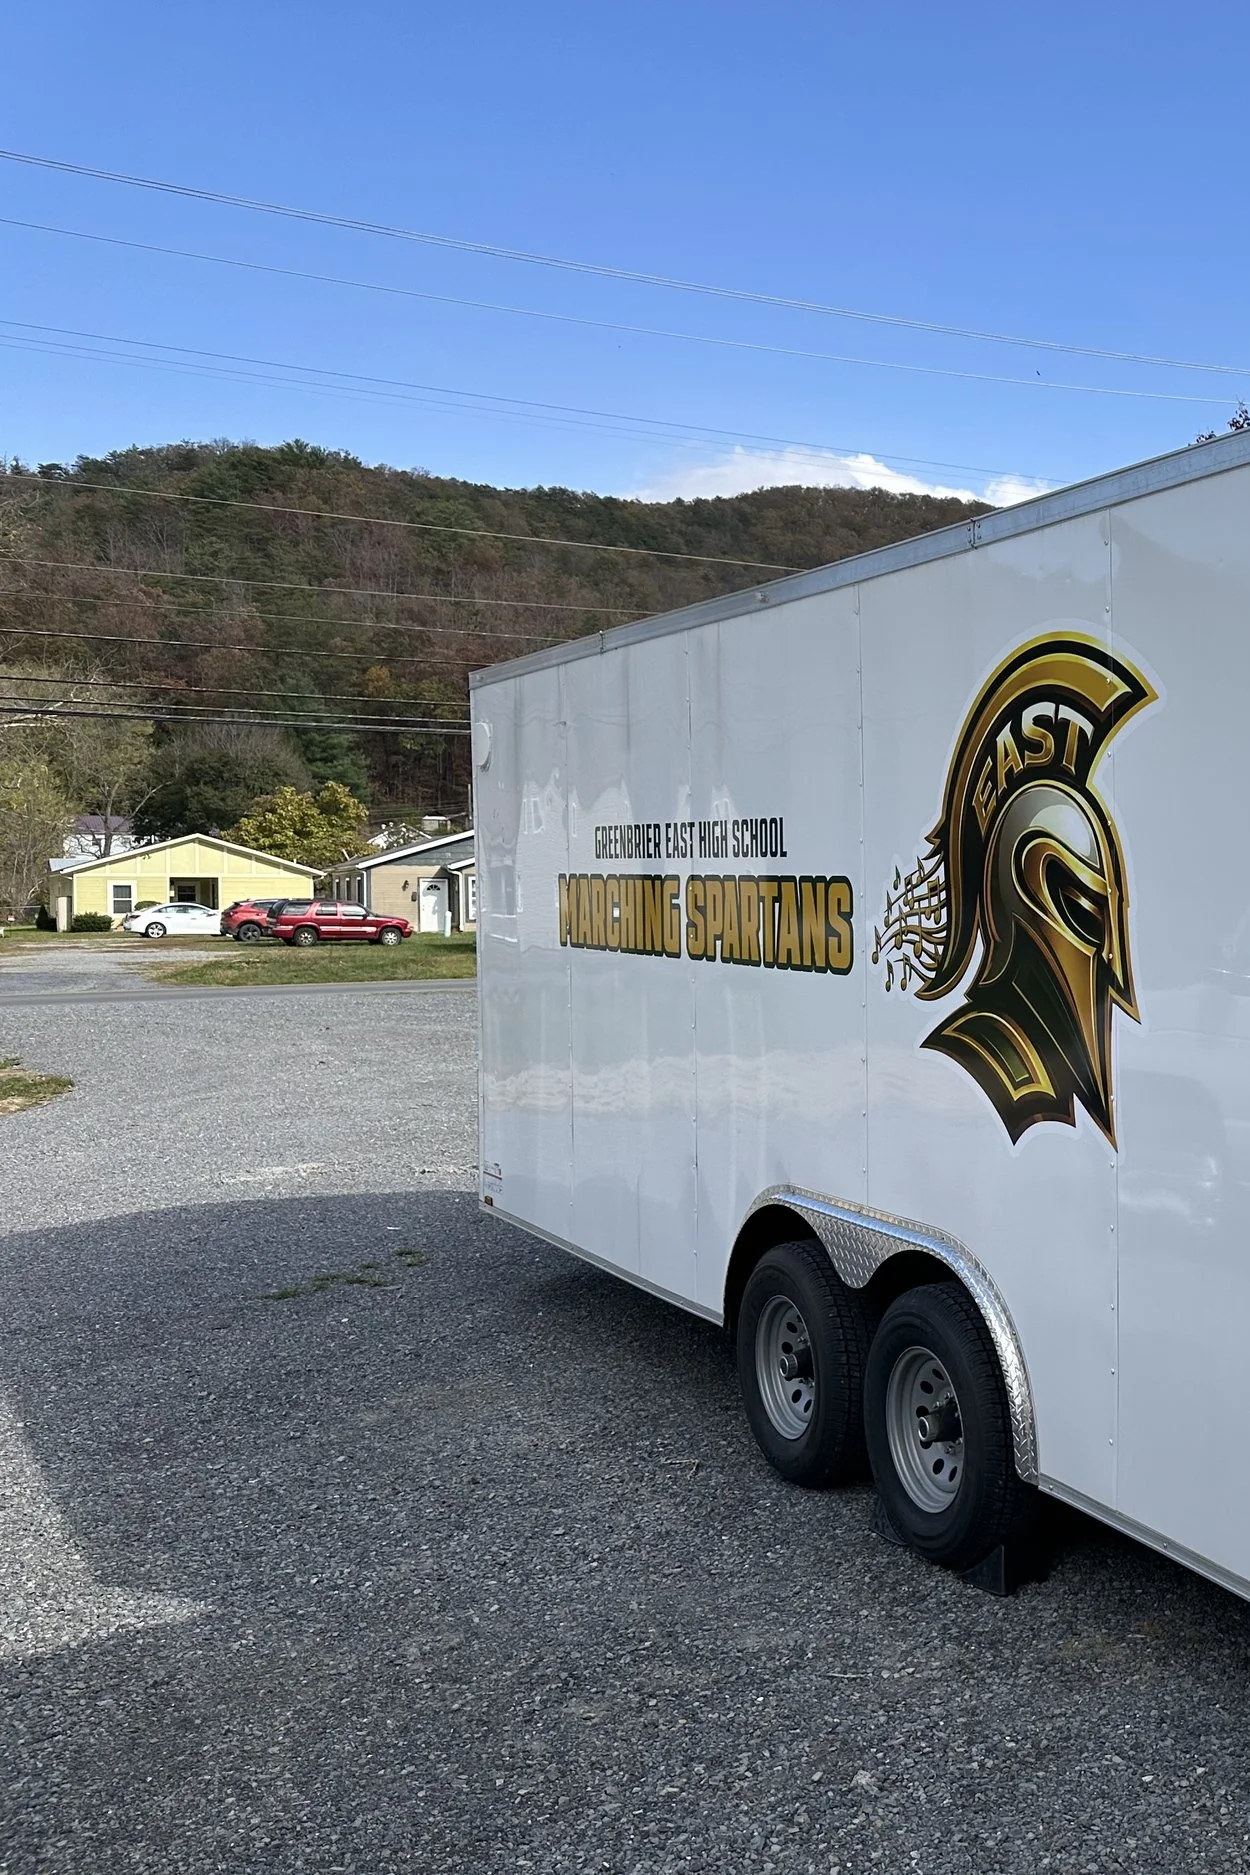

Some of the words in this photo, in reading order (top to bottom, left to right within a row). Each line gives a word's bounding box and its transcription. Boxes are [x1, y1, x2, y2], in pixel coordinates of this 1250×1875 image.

[972, 701, 1095, 837] EAST
[594, 823, 661, 859] GREENBRIER
[665, 821, 695, 859] EAST
[698, 819, 728, 858] HIGH
[732, 817, 787, 858] SCHOOL
[558, 873, 681, 959] MARCHING
[685, 874, 854, 976] SPARTANS
